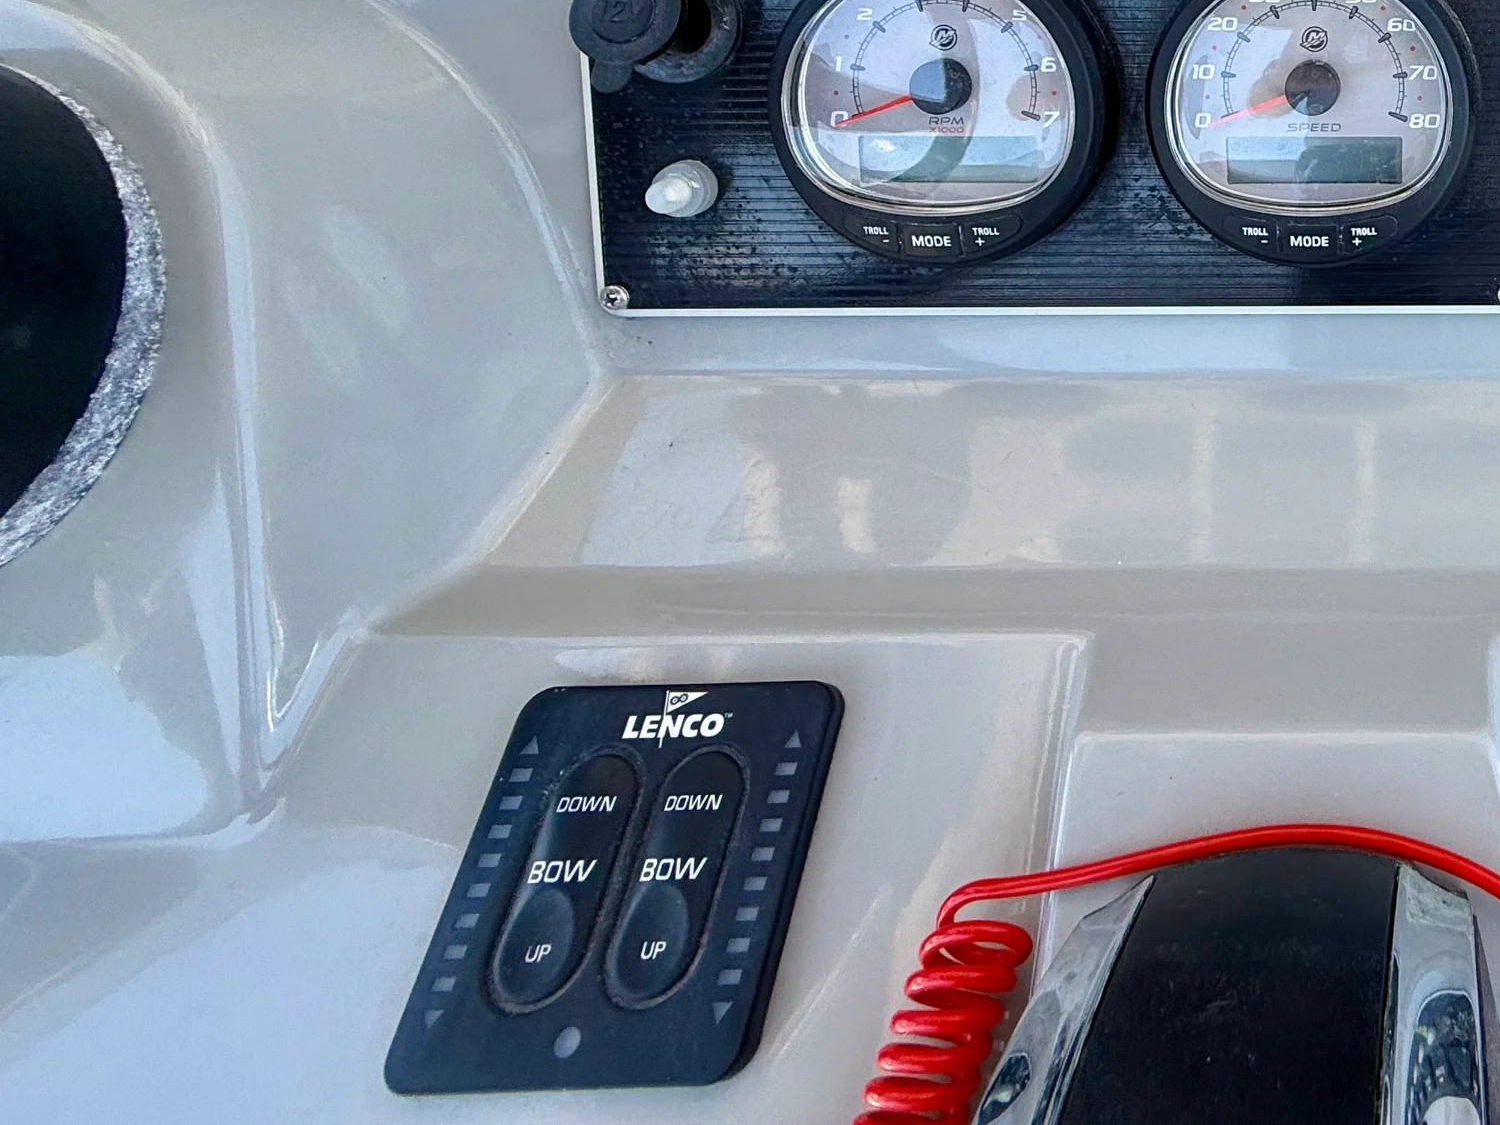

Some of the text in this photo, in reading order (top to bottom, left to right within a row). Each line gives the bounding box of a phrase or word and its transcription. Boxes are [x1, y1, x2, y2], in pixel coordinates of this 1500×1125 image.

[856, 8, 873, 20] 2
[1011, 9, 1027, 21] 5
[1207, 18, 1238, 31] 20
[1387, 18, 1415, 32] 60
[835, 57, 842, 71] 1
[1041, 58, 1056, 72] 6
[1192, 66, 1215, 80] 10
[1408, 66, 1437, 80] 70
[830, 111, 849, 127] 0
[928, 116, 964, 125] RPM
[1042, 111, 1060, 127] 7
[1194, 114, 1211, 127] 0
[1408, 115, 1440, 129] 80
[1287, 122, 1342, 132] SPEED
[863, 227, 889, 235] TROLL
[972, 227, 1000, 235] TROLL
[1242, 227, 1268, 236] TROLL
[1350, 227, 1377, 236] TROLL
[911, 235, 952, 247] MODE
[1290, 235, 1329, 247] MODE
[622, 713, 725, 741] LENCO
[556, 796, 617, 812] DOWN
[663, 794, 723, 811] DOWN
[527, 859, 597, 884] BOW
[639, 857, 707, 882] BOW
[524, 944, 551, 962] UP
[640, 941, 666, 959] UP
